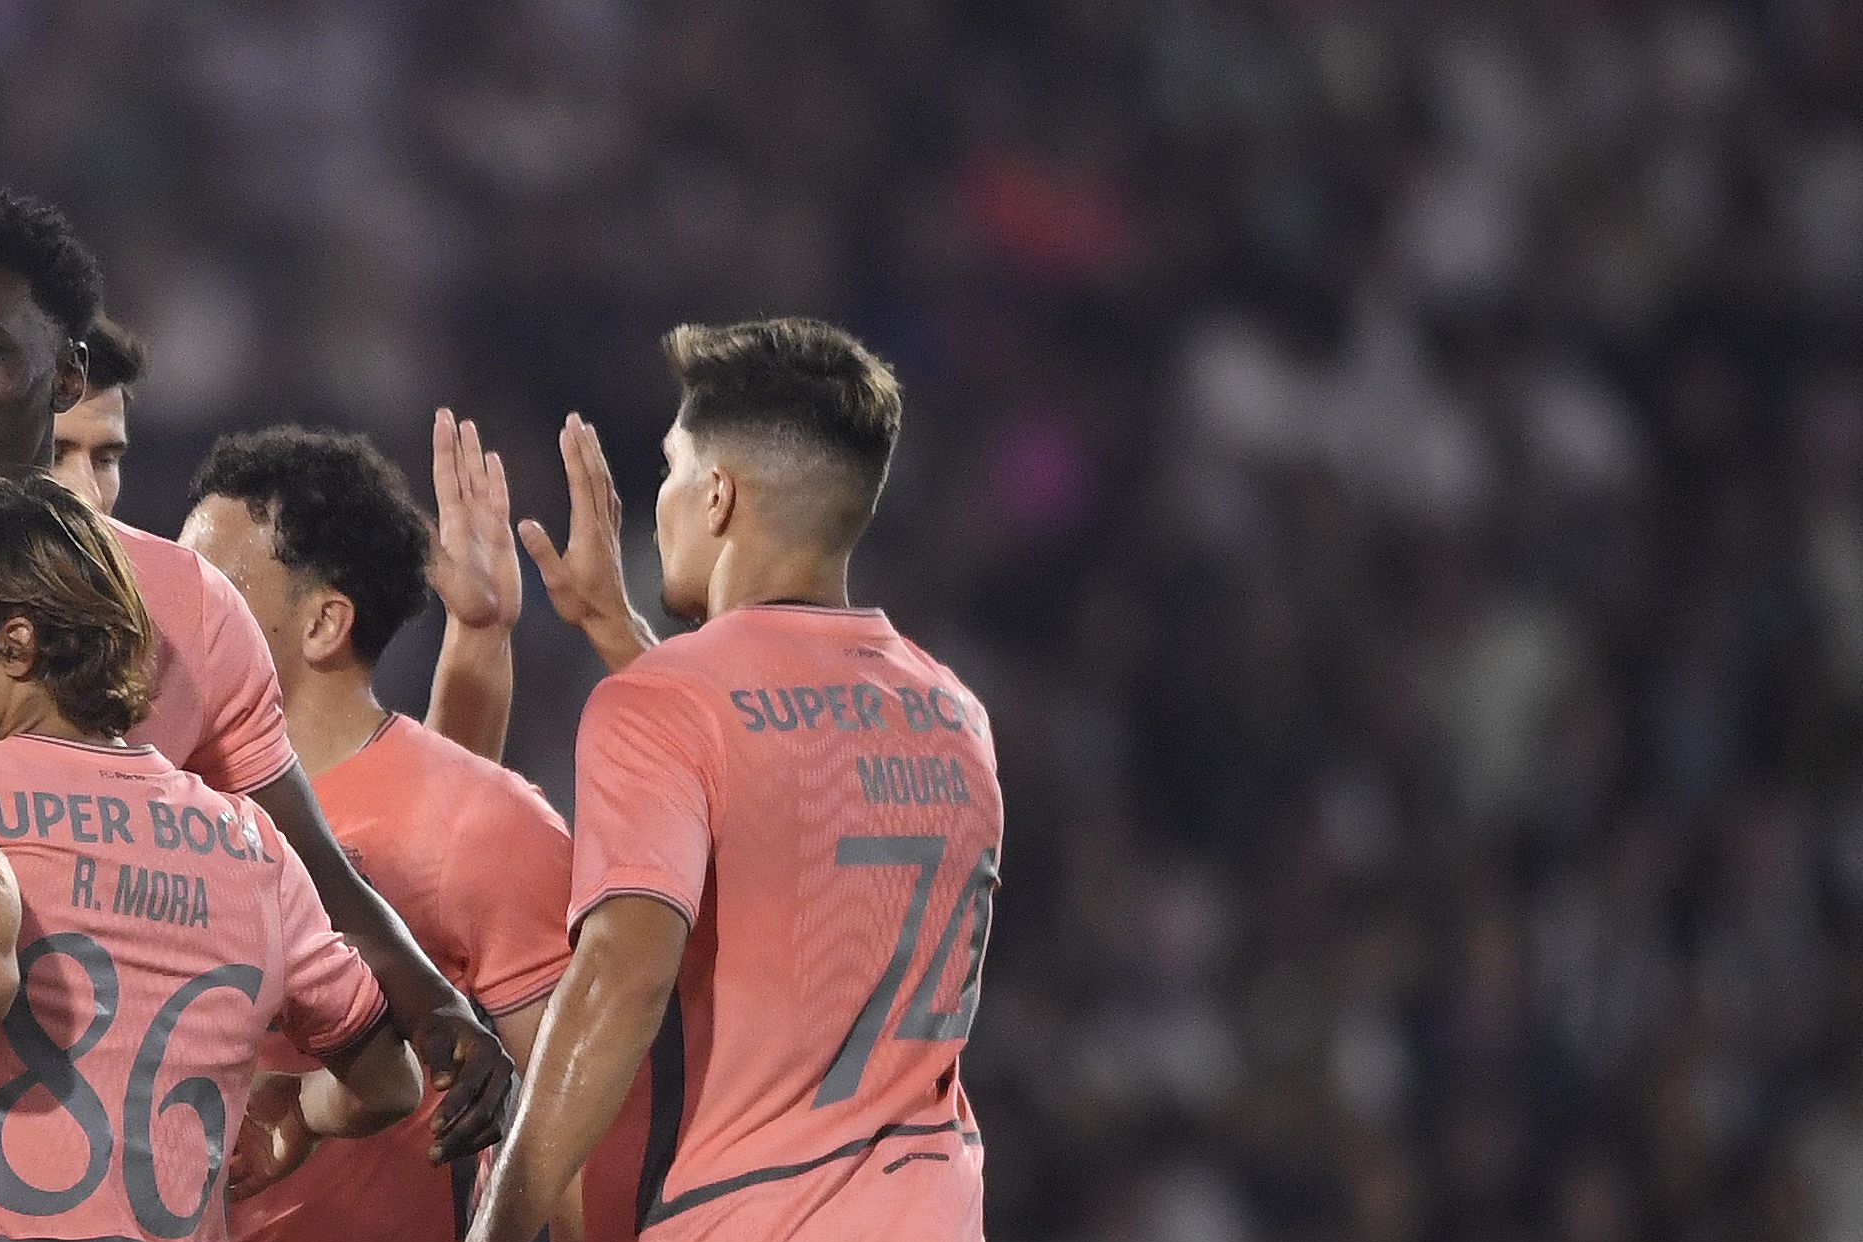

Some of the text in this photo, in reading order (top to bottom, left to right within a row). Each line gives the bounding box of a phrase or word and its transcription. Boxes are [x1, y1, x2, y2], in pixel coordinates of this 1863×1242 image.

[729, 683, 888, 733] SUPER
[856, 756, 970, 806] MOURA
[147, 799, 276, 864] BOCK
[72, 854, 209, 929] R. MORA
[810, 836, 1002, 1110] 74
